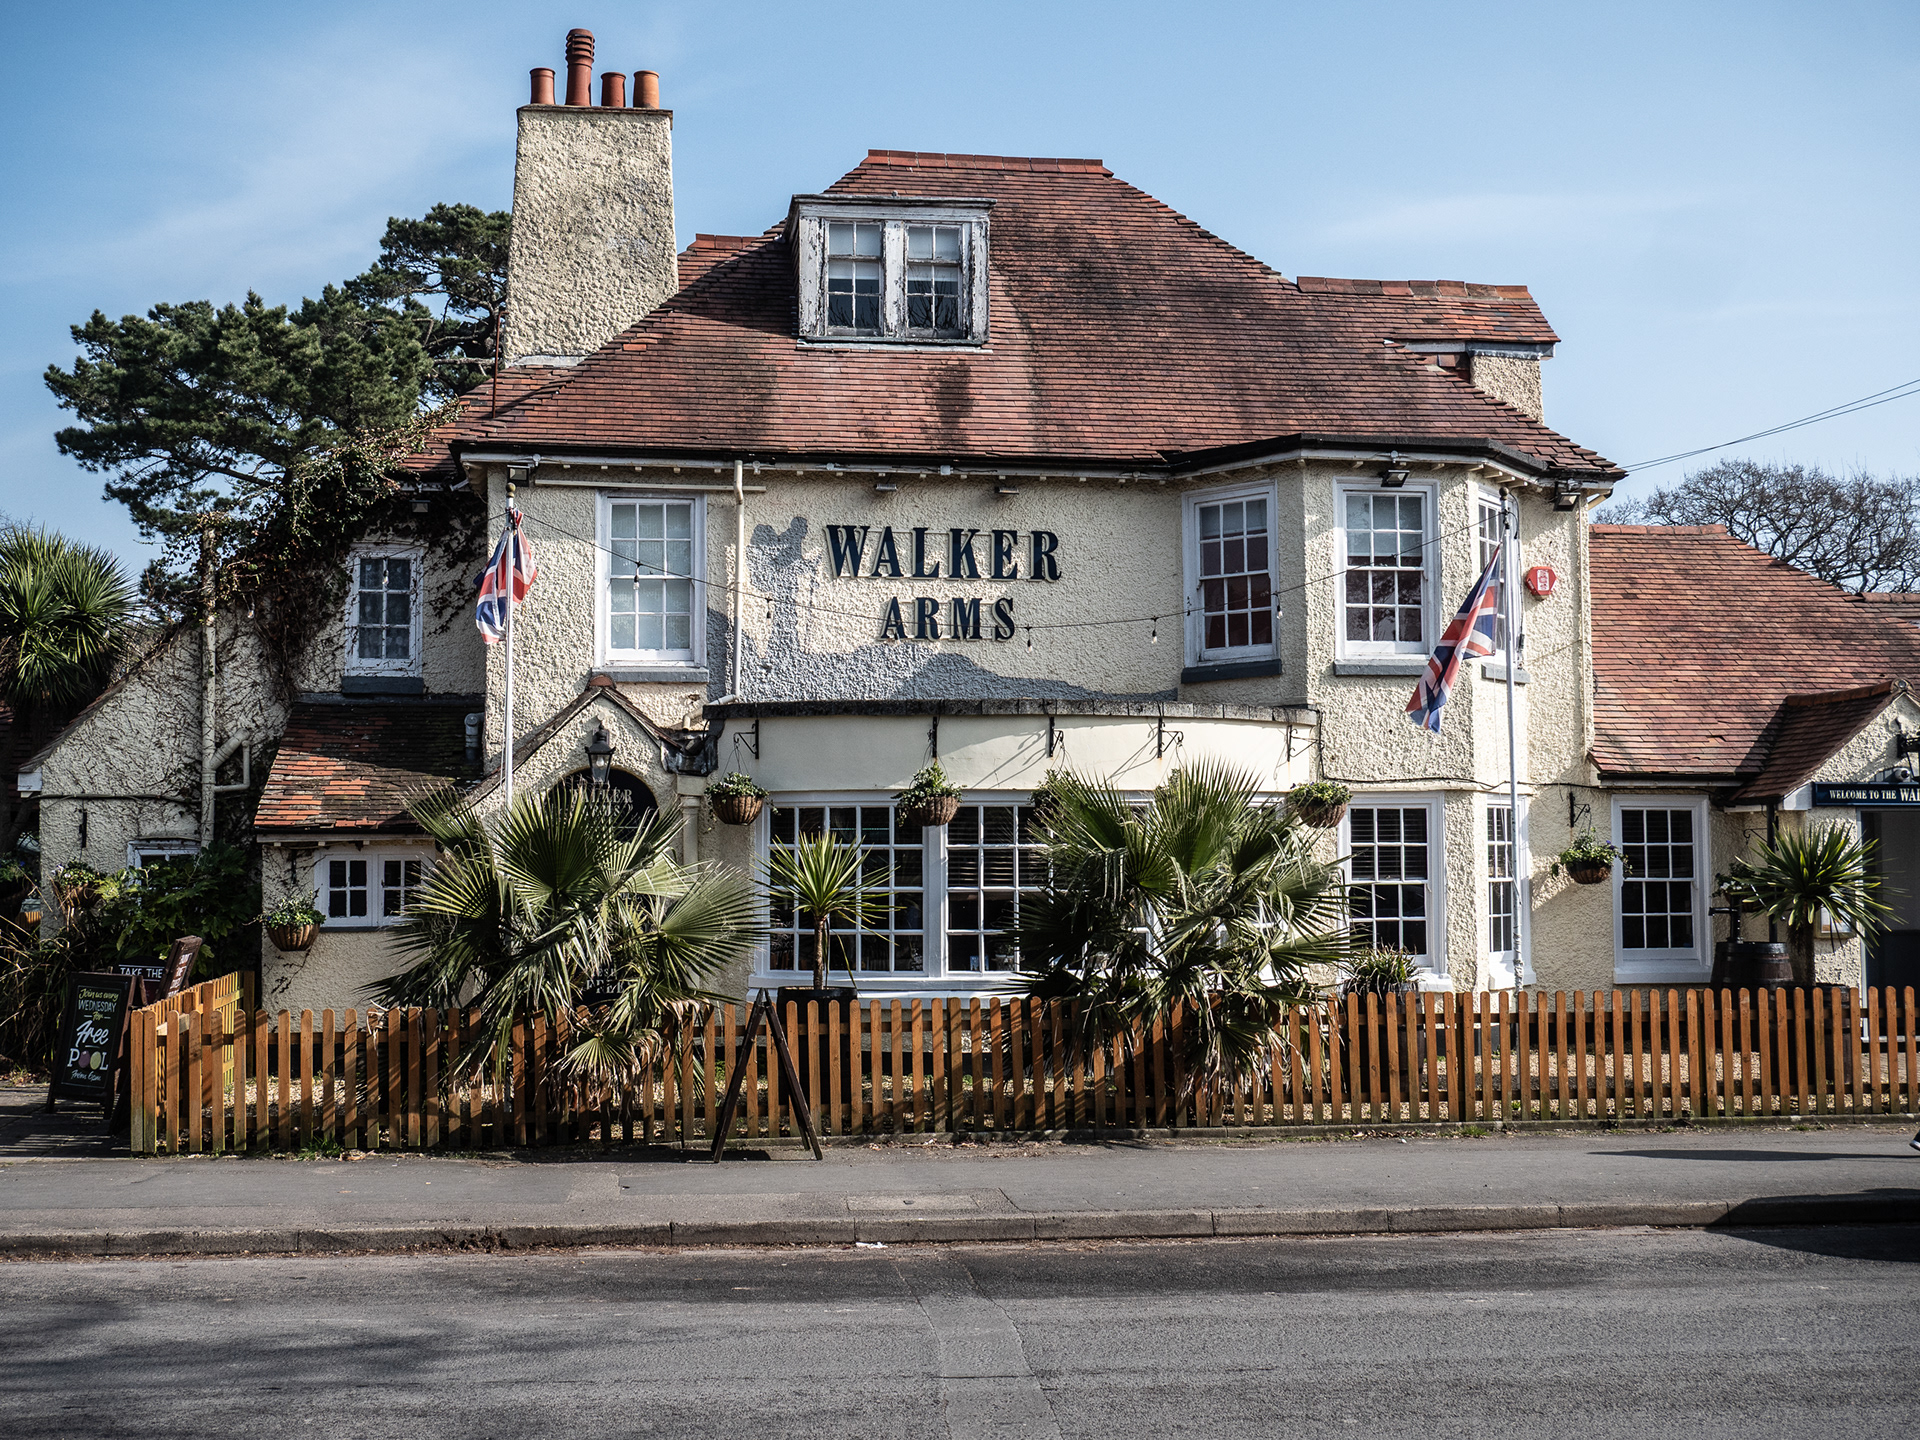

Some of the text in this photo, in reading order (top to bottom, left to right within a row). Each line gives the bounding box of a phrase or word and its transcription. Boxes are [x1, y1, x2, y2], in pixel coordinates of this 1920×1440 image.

[824, 524, 1062, 581] WALKER
[878, 596, 1016, 641] ARMS
[1829, 789, 1867, 799] WELCOME
[1869, 790, 1879, 799] TO
[1881, 790, 1897, 799] THE
[120, 967, 163, 978] TAKE THE
[78, 999, 117, 1012] WEDNESDAY
[75, 1019, 109, 1048] Free
